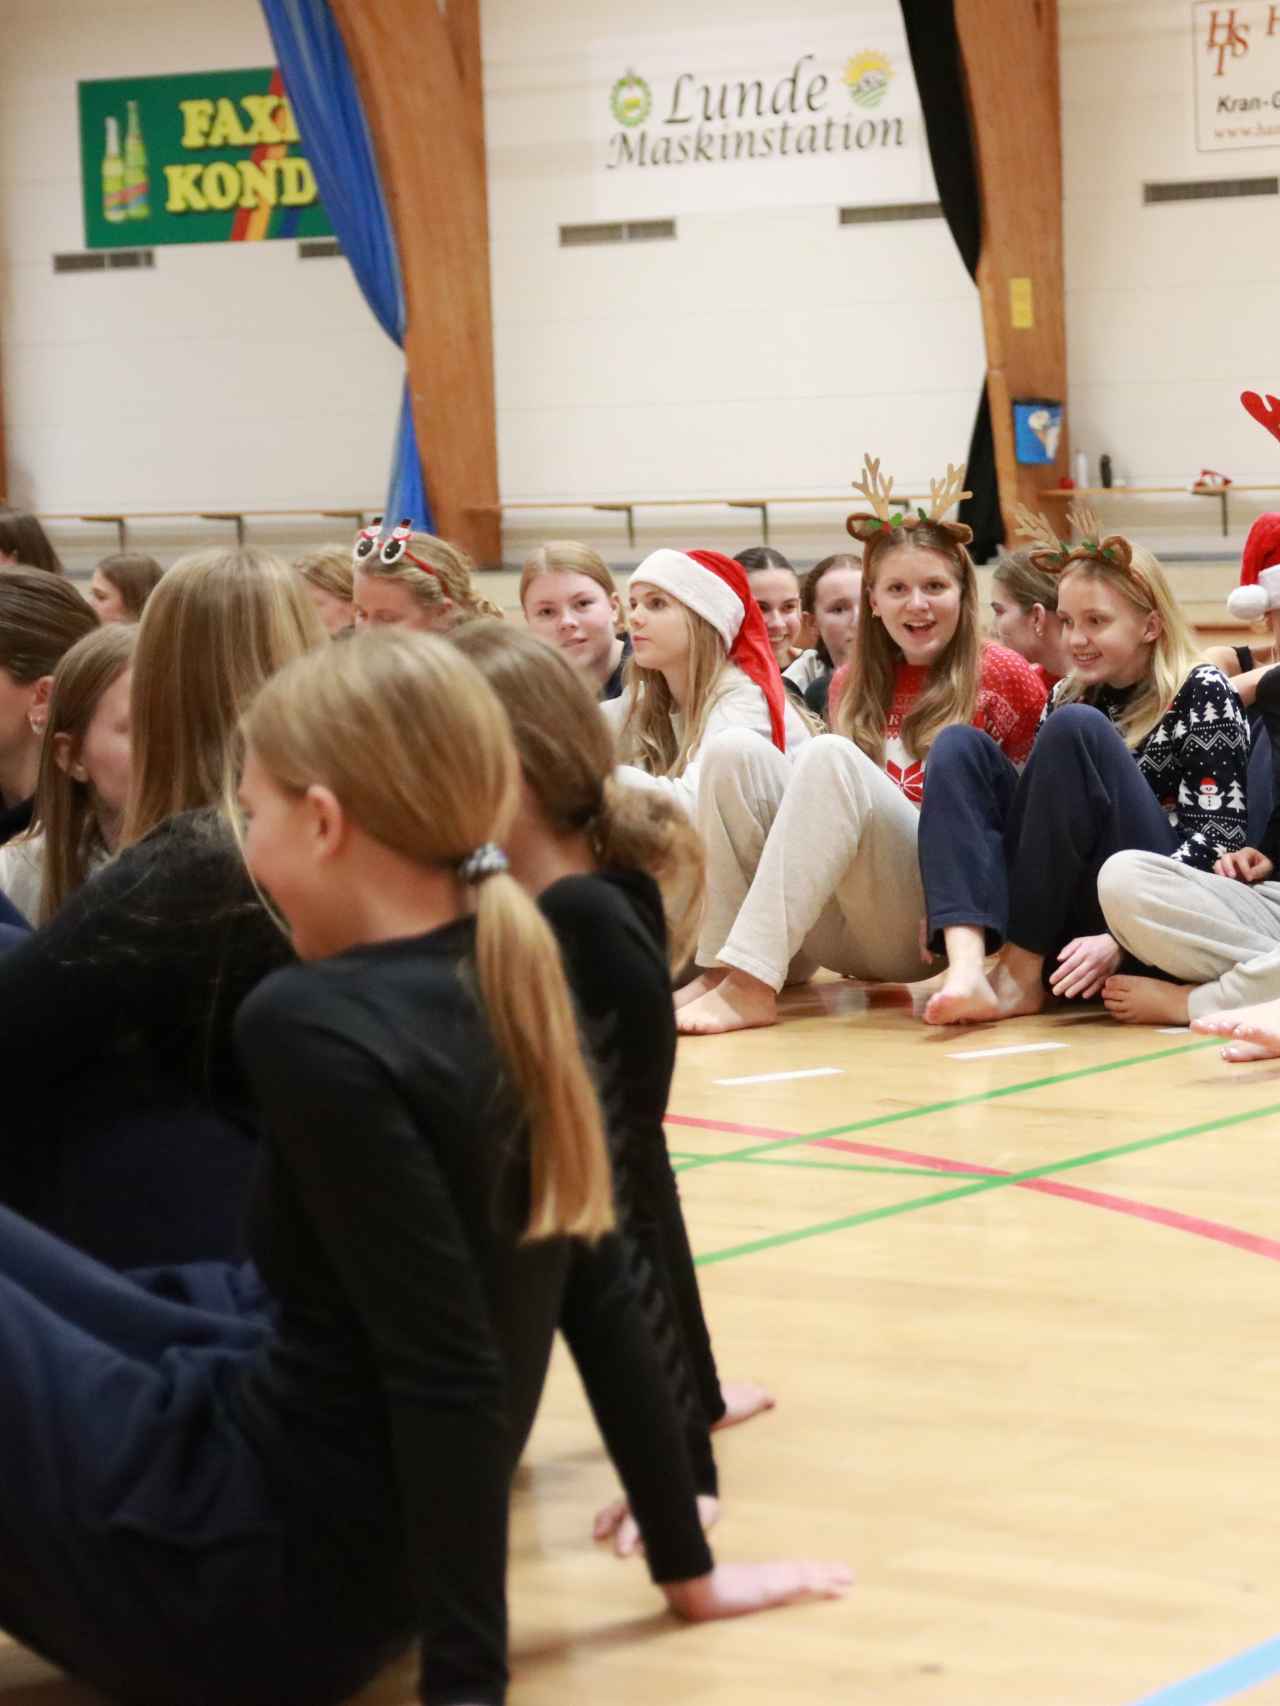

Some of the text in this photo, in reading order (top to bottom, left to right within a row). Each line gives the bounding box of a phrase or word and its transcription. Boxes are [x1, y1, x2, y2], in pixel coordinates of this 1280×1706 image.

[663, 53, 829, 124] Lunde
[604, 111, 905, 170] Maskinstation
[163, 156, 319, 214] KOND
